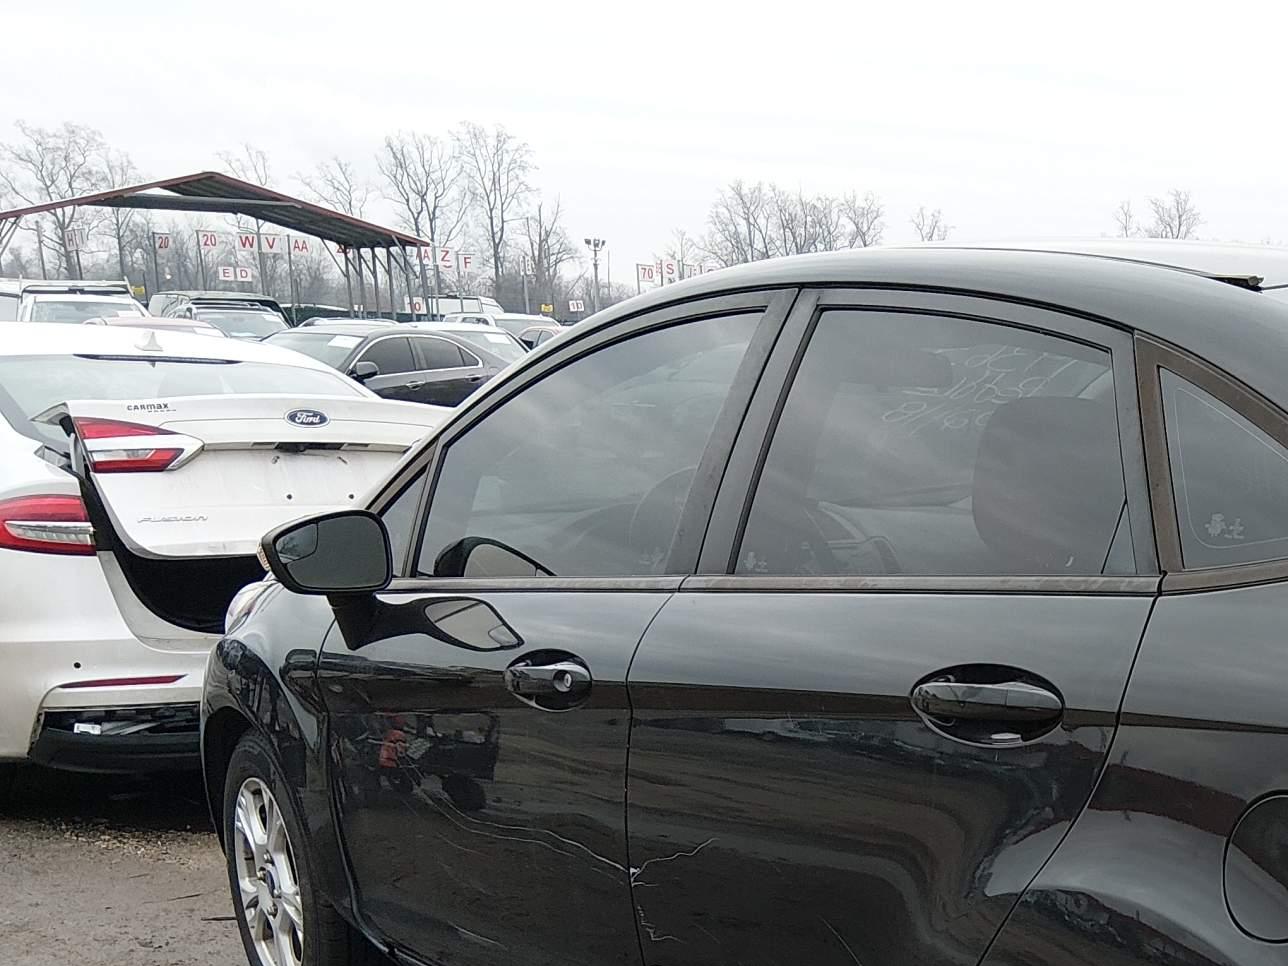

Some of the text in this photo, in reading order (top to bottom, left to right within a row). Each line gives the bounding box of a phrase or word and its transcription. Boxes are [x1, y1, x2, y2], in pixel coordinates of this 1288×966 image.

[158, 236, 170, 249] 20
[203, 234, 217, 247] 20
[240, 235, 276, 249] W V
[293, 240, 309, 253] AA
[463, 256, 472, 269] F
[666, 263, 675, 275] S
[223, 268, 248, 279] E D
[641, 267, 654, 279] 70
[294, 411, 320, 424] Ford
